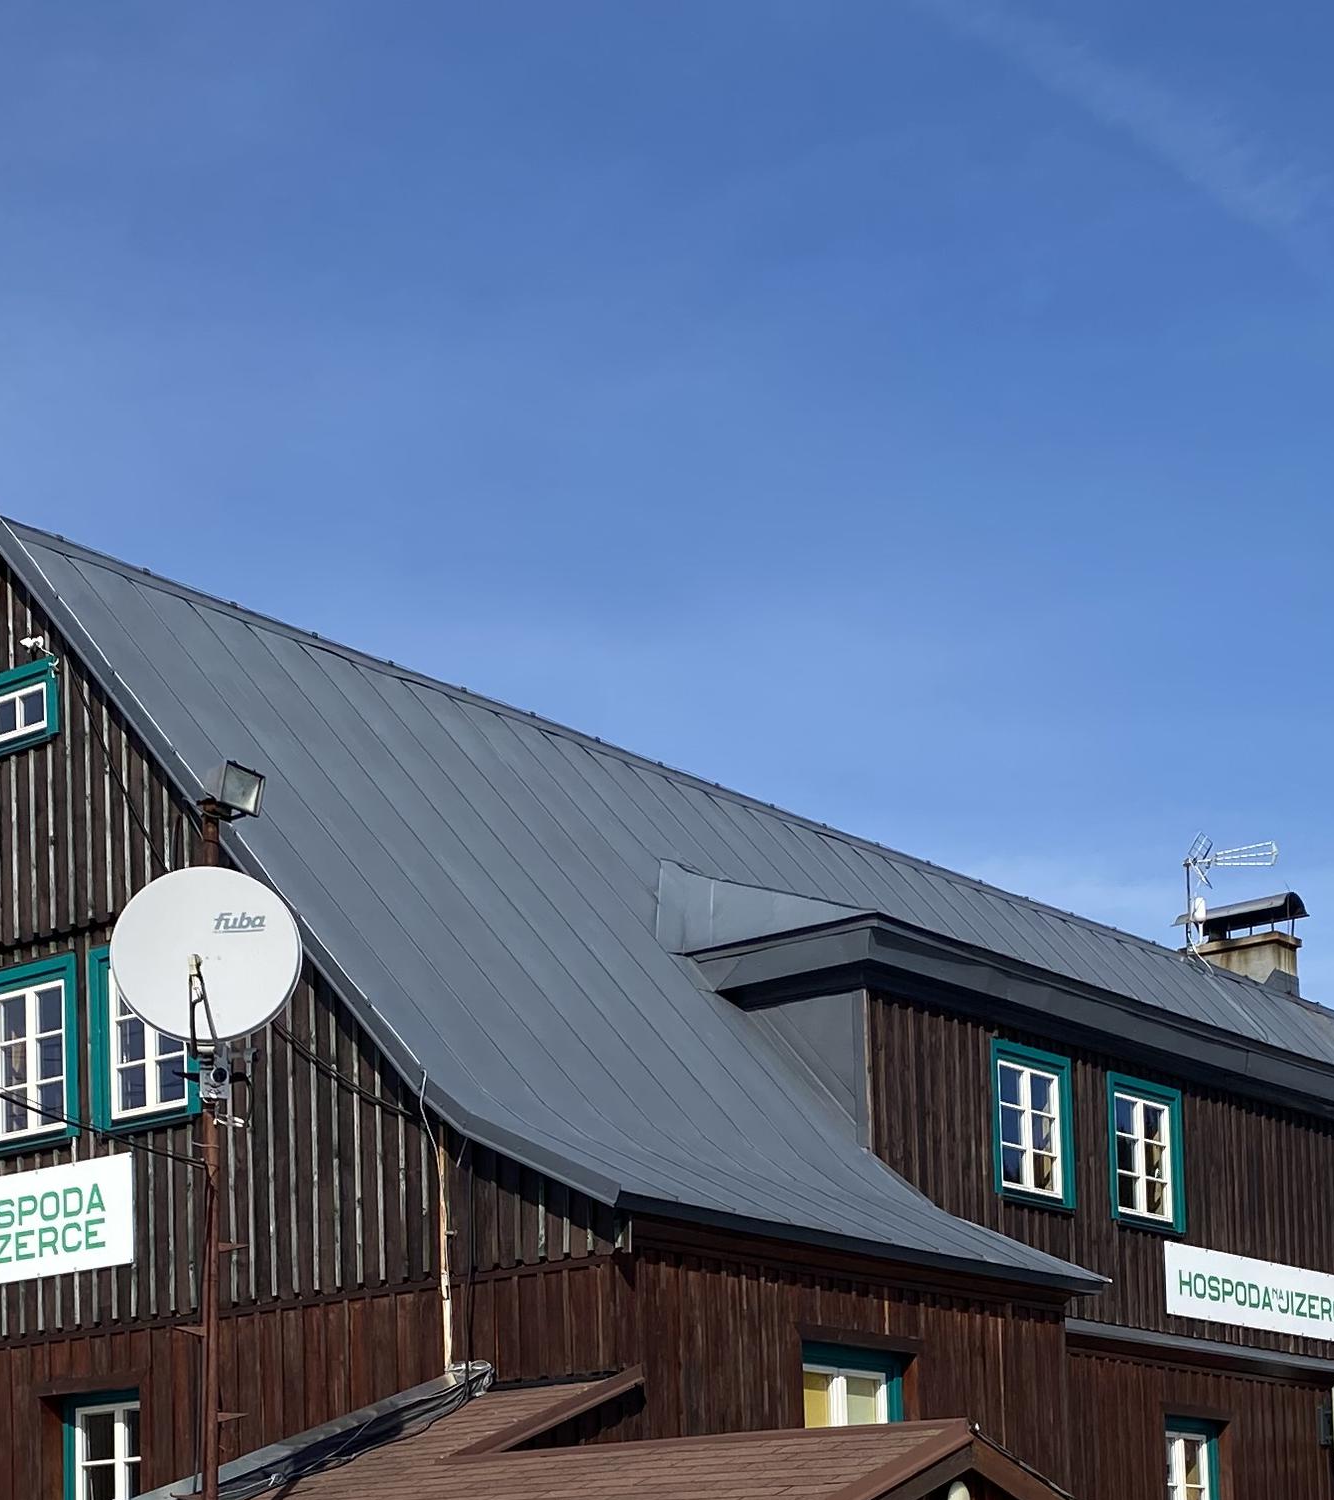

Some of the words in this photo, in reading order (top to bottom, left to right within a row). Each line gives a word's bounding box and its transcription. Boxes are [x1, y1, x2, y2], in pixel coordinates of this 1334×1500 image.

[214, 912, 266, 931] fuba
[1178, 1269, 1273, 1312] HOSPODA
[1271, 1287, 1285, 1301] NA
